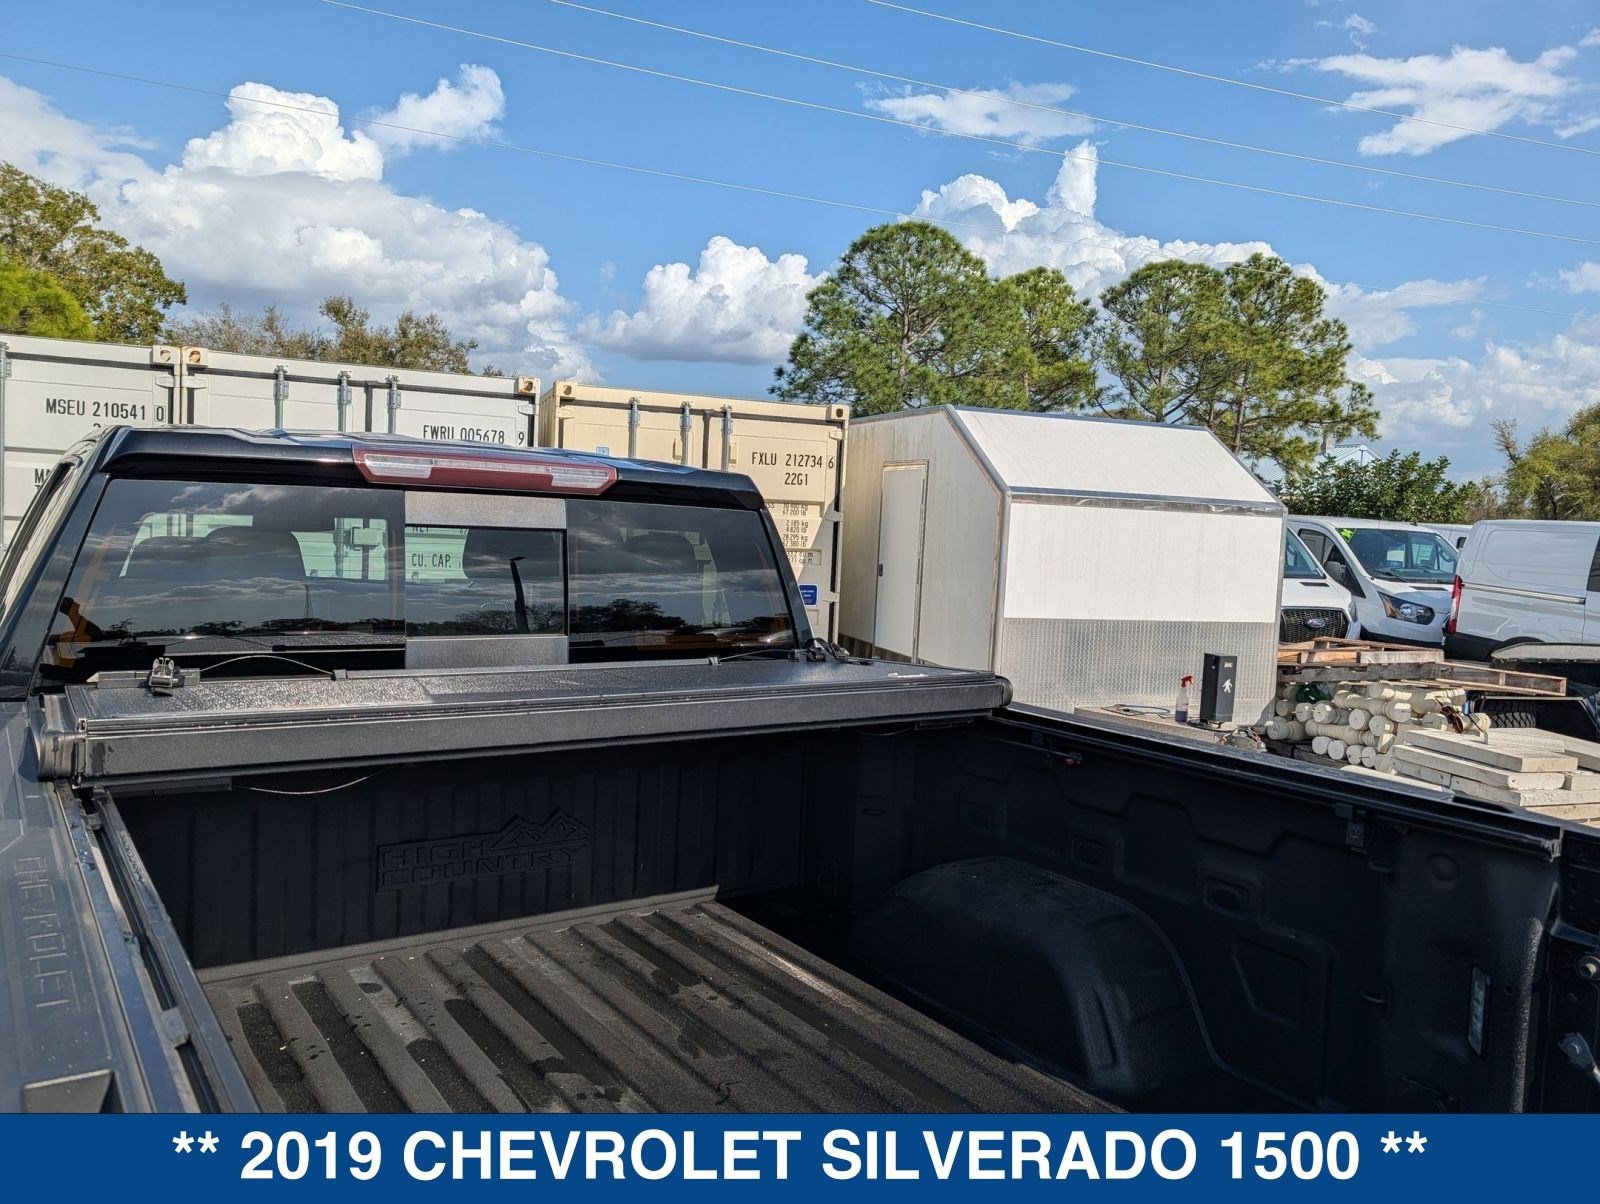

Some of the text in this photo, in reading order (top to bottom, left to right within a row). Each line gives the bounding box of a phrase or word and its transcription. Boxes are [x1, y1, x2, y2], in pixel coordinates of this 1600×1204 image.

[46, 398, 164, 422] MSEU 210541 0
[460, 428, 505, 445] 005678
[518, 431, 525, 446] 9
[752, 452, 834, 469] FXLU 212734 6
[784, 472, 808, 486] 22G1
[411, 553, 427, 568] CU.
[432, 553, 452, 568] CAP.
[382, 838, 494, 868] HIGH
[382, 844, 589, 888] COUNTRY
